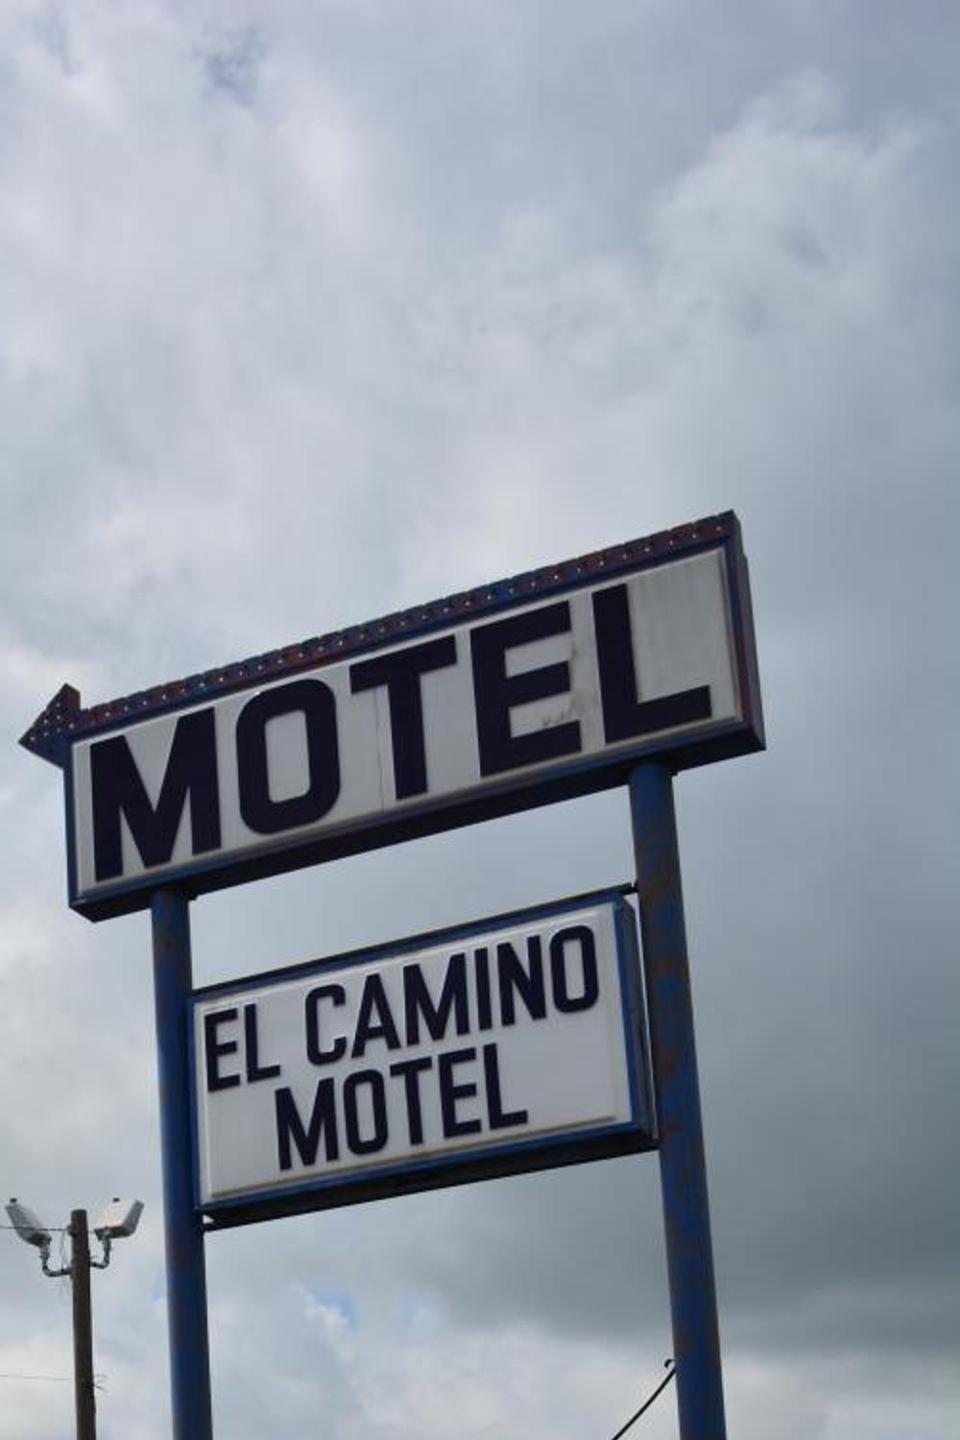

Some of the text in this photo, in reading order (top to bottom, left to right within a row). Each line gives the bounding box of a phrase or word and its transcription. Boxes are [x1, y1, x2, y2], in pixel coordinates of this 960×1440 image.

[90, 584, 712, 882] MOTEL
[204, 925, 599, 1092] EL CAMINO
[275, 1044, 528, 1170] MOTEL
